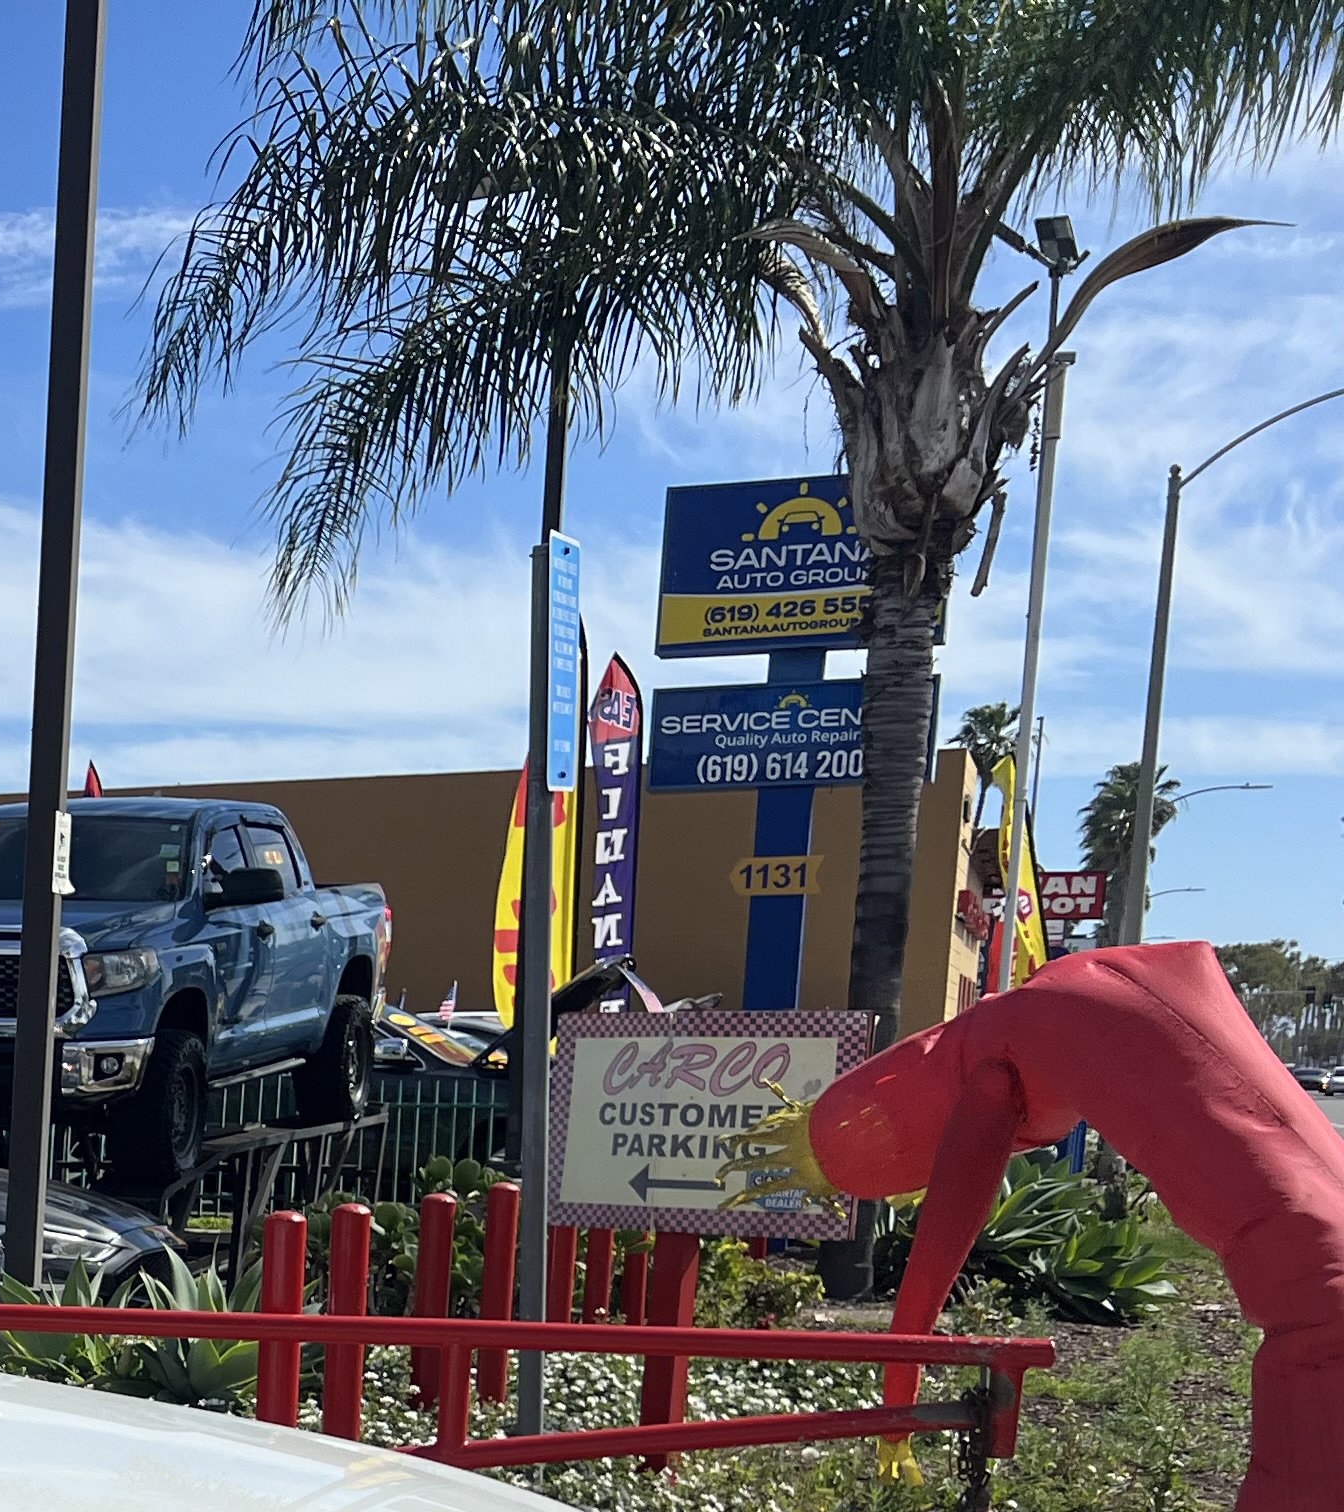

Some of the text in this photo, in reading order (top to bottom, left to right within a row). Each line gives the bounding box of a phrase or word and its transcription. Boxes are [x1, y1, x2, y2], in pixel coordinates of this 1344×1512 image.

[716, 572, 784, 590] AUTO
[704, 603, 759, 626] (619)
[766, 600, 816, 619] 426
[661, 710, 791, 735] SERVICE
[714, 728, 861, 749] Quality Auto Repair
[696, 752, 759, 783] (619)
[765, 750, 808, 781] 614
[739, 862, 806, 889] 1131
[603, 1041, 791, 1097] CARCO
[612, 1133, 766, 1160] PARKING
